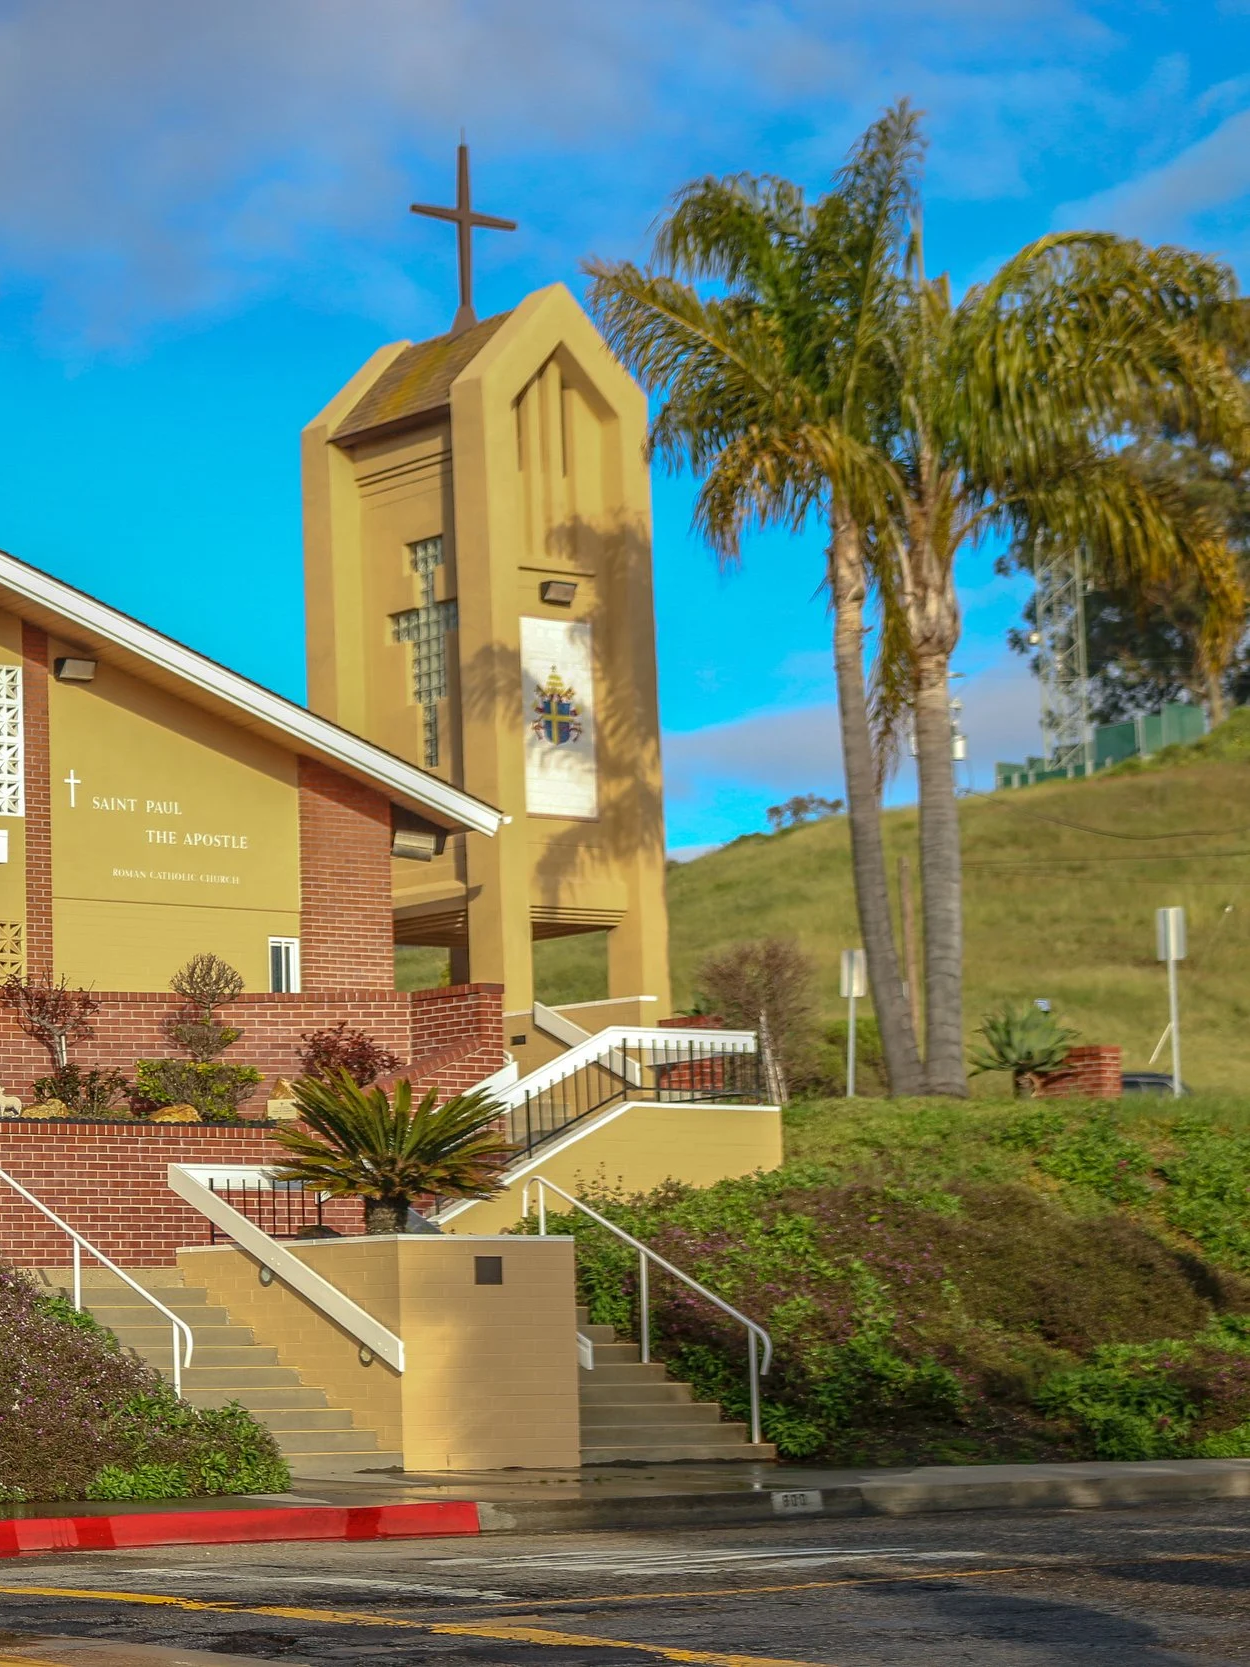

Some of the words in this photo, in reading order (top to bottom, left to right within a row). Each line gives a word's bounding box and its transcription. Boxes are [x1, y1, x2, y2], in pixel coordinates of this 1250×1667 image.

[92, 797, 137, 812] SAINT
[146, 800, 182, 815] PAUL
[145, 830, 177, 845] THE
[183, 833, 248, 849] APOSTLE
[112, 868, 146, 879] ROMAN
[149, 870, 197, 882] CATHOLIC
[200, 874, 239, 885] CHURCH
